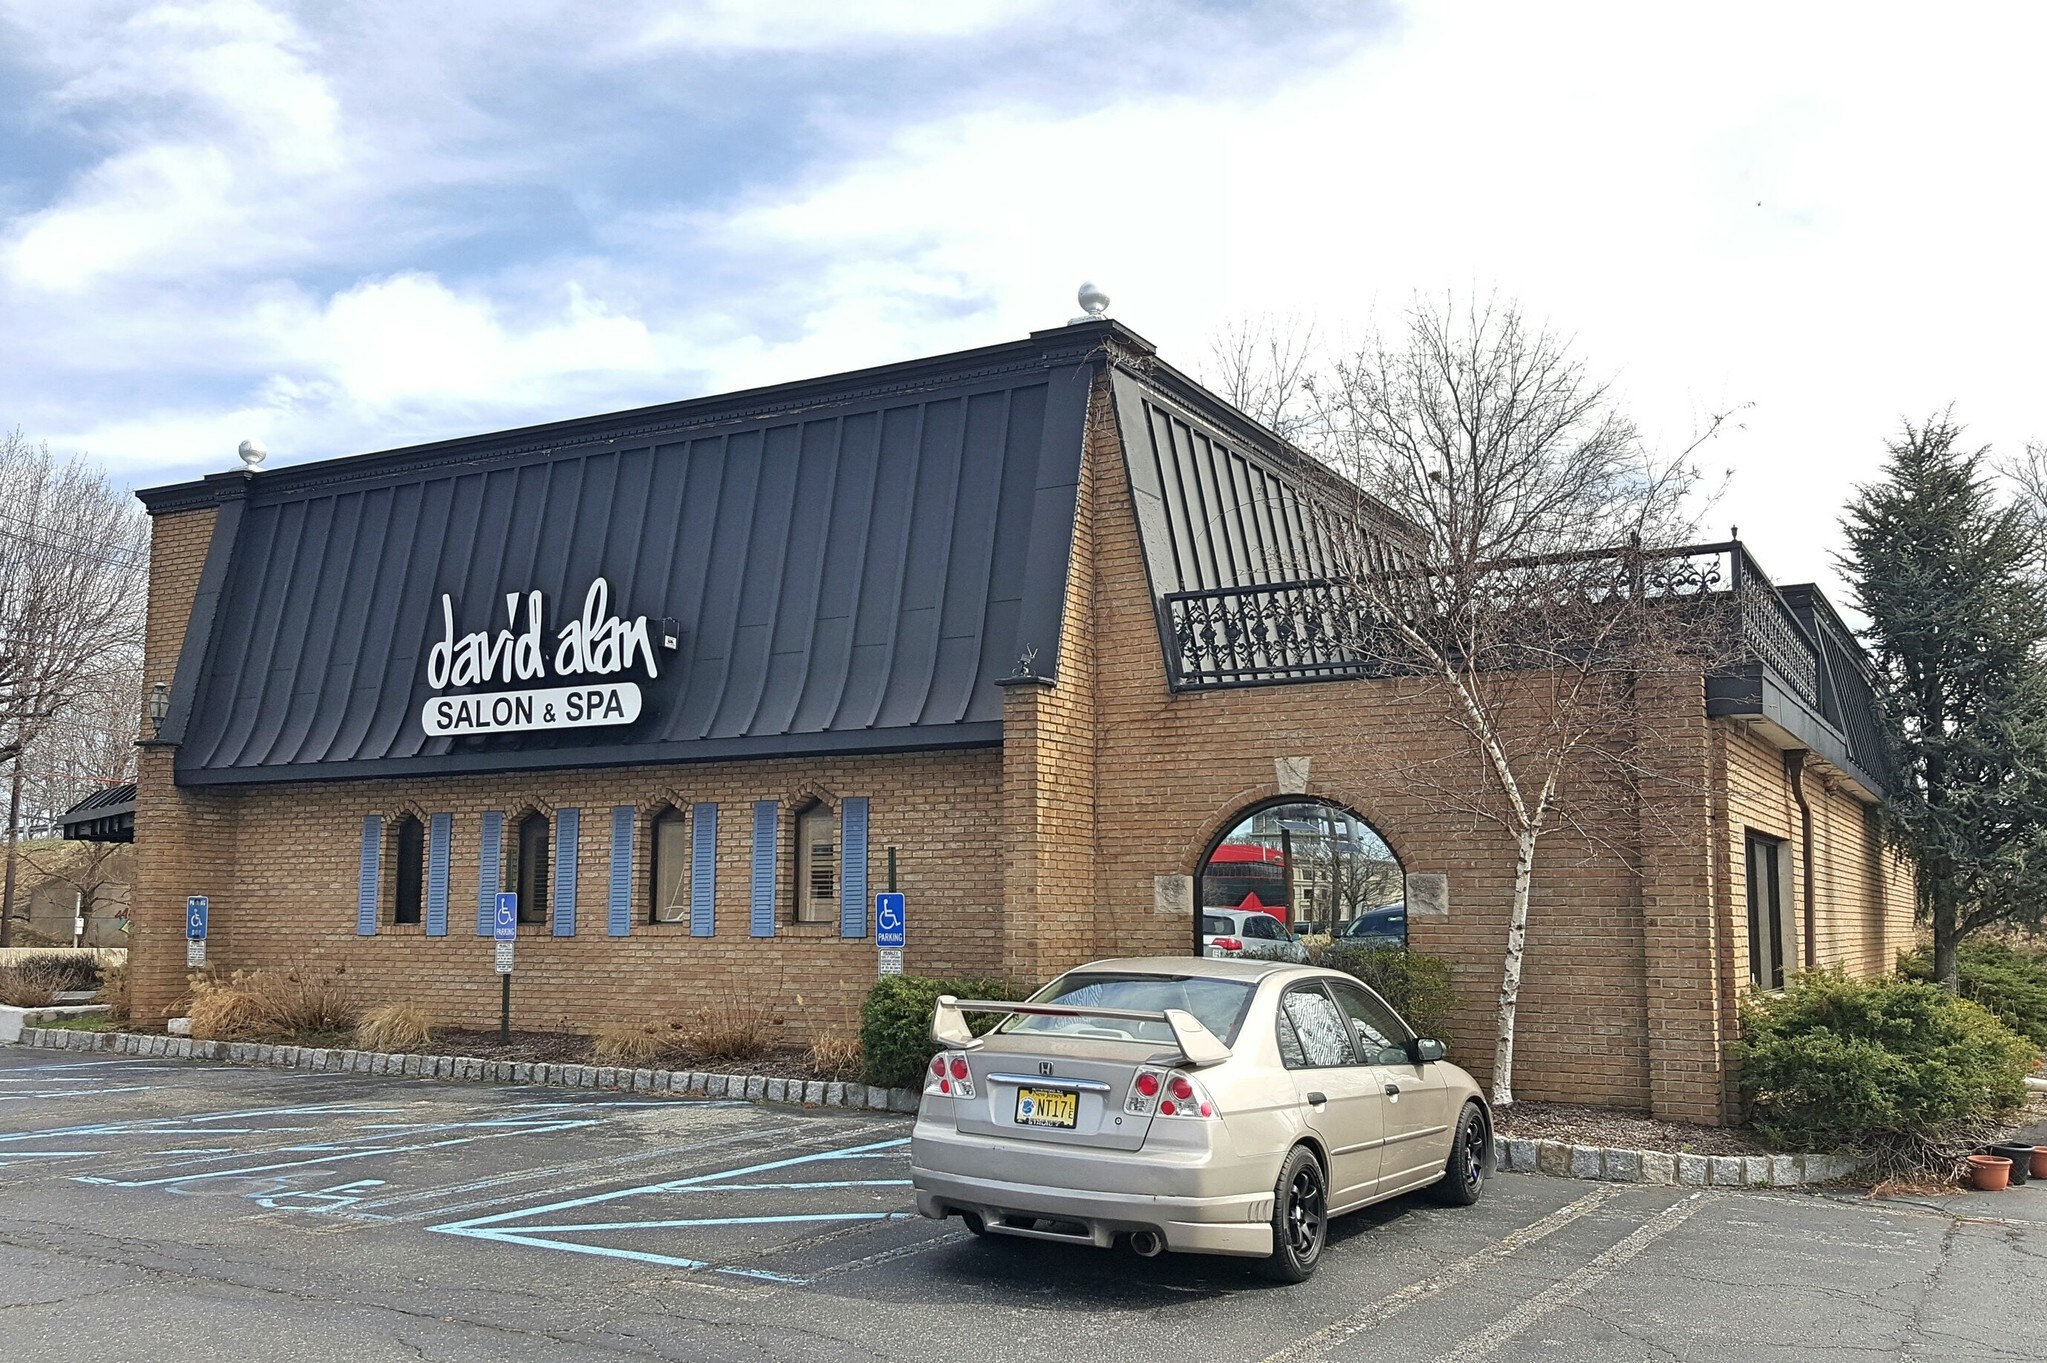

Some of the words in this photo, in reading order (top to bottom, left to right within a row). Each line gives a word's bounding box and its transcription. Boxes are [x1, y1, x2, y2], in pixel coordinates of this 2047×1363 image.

[428, 590, 545, 690] david
[555, 577, 658, 679] alan
[436, 695, 533, 730] SALON
[543, 703, 556, 723] &
[566, 689, 625, 721] SPA
[878, 933, 903, 942] PARKING
[1037, 1098, 1068, 1118] NT17
